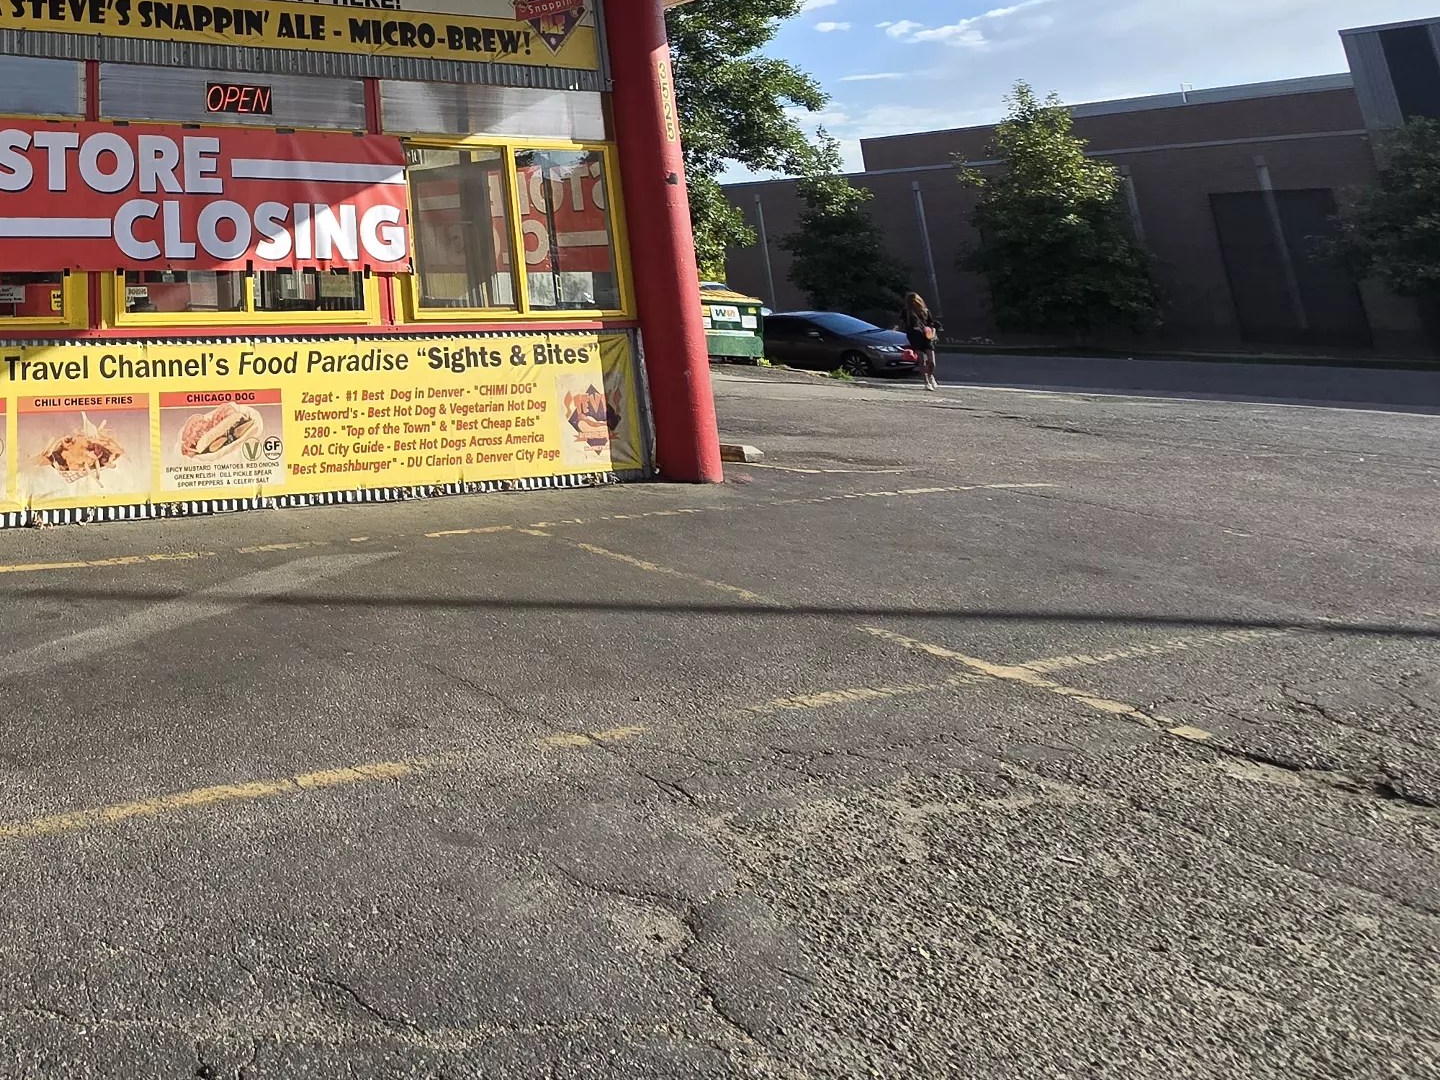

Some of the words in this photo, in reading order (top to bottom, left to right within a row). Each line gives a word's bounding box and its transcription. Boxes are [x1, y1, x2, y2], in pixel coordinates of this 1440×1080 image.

[137, 0, 269, 36] SNAPPIN'
[277, 13, 325, 40] ALE
[350, 18, 531, 56] MICRO-BREW!
[207, 85, 271, 112] OPEN
[659, 62, 675, 140] 3525
[113, 200, 407, 262] CLOSING
[5, 355, 89, 381] Travel
[100, 352, 230, 379] Channel's
[239, 351, 298, 376] Food
[307, 349, 409, 374] Paradise
[417, 346, 502, 373] "Sights
[510, 346, 527, 366] &
[34, 397, 61, 407] CHILI
[64, 397, 103, 406] CHEESE
[105, 395, 133, 405] FRIES
[186, 393, 232, 403] CHICAGO
[234, 392, 255, 401] DOG
[301, 390, 334, 405] Zagat
[345, 389, 358, 402] #1
[362, 388, 385, 401] Best
[391, 387, 412, 402] Dog
[414, 386, 425, 399] in
[428, 385, 465, 399] Denver
[294, 407, 359, 421] Westword's
[367, 405, 391, 418] Best
[393, 404, 412, 417] Hot
[415, 403, 436, 418] Dog
[439, 403, 447, 415] &
[450, 400, 505, 417] Vegetarian
[507, 399, 525, 412] Hot
[527, 398, 547, 413] Dog
[304, 426, 331, 438] 5280
[368, 423, 380, 435] of
[382, 422, 400, 435] the
[439, 420, 447, 432] &
[481, 417, 512, 433] Cheap
[245, 442, 259, 460] V
[264, 441, 281, 451] GF
[301, 444, 325, 457] AOL
[327, 442, 349, 458] City
[352, 441, 384, 455] Guide
[393, 439, 417, 452] Best
[419, 438, 439, 450] Hot
[441, 436, 467, 452] Dogs
[469, 435, 503, 447] Across
[505, 432, 545, 445] America
[407, 455, 422, 467] DU
[425, 453, 463, 467] Clarion
[465, 452, 474, 464] &
[476, 450, 513, 464] Denver
[515, 449, 535, 463] City
[537, 448, 560, 463] Page
